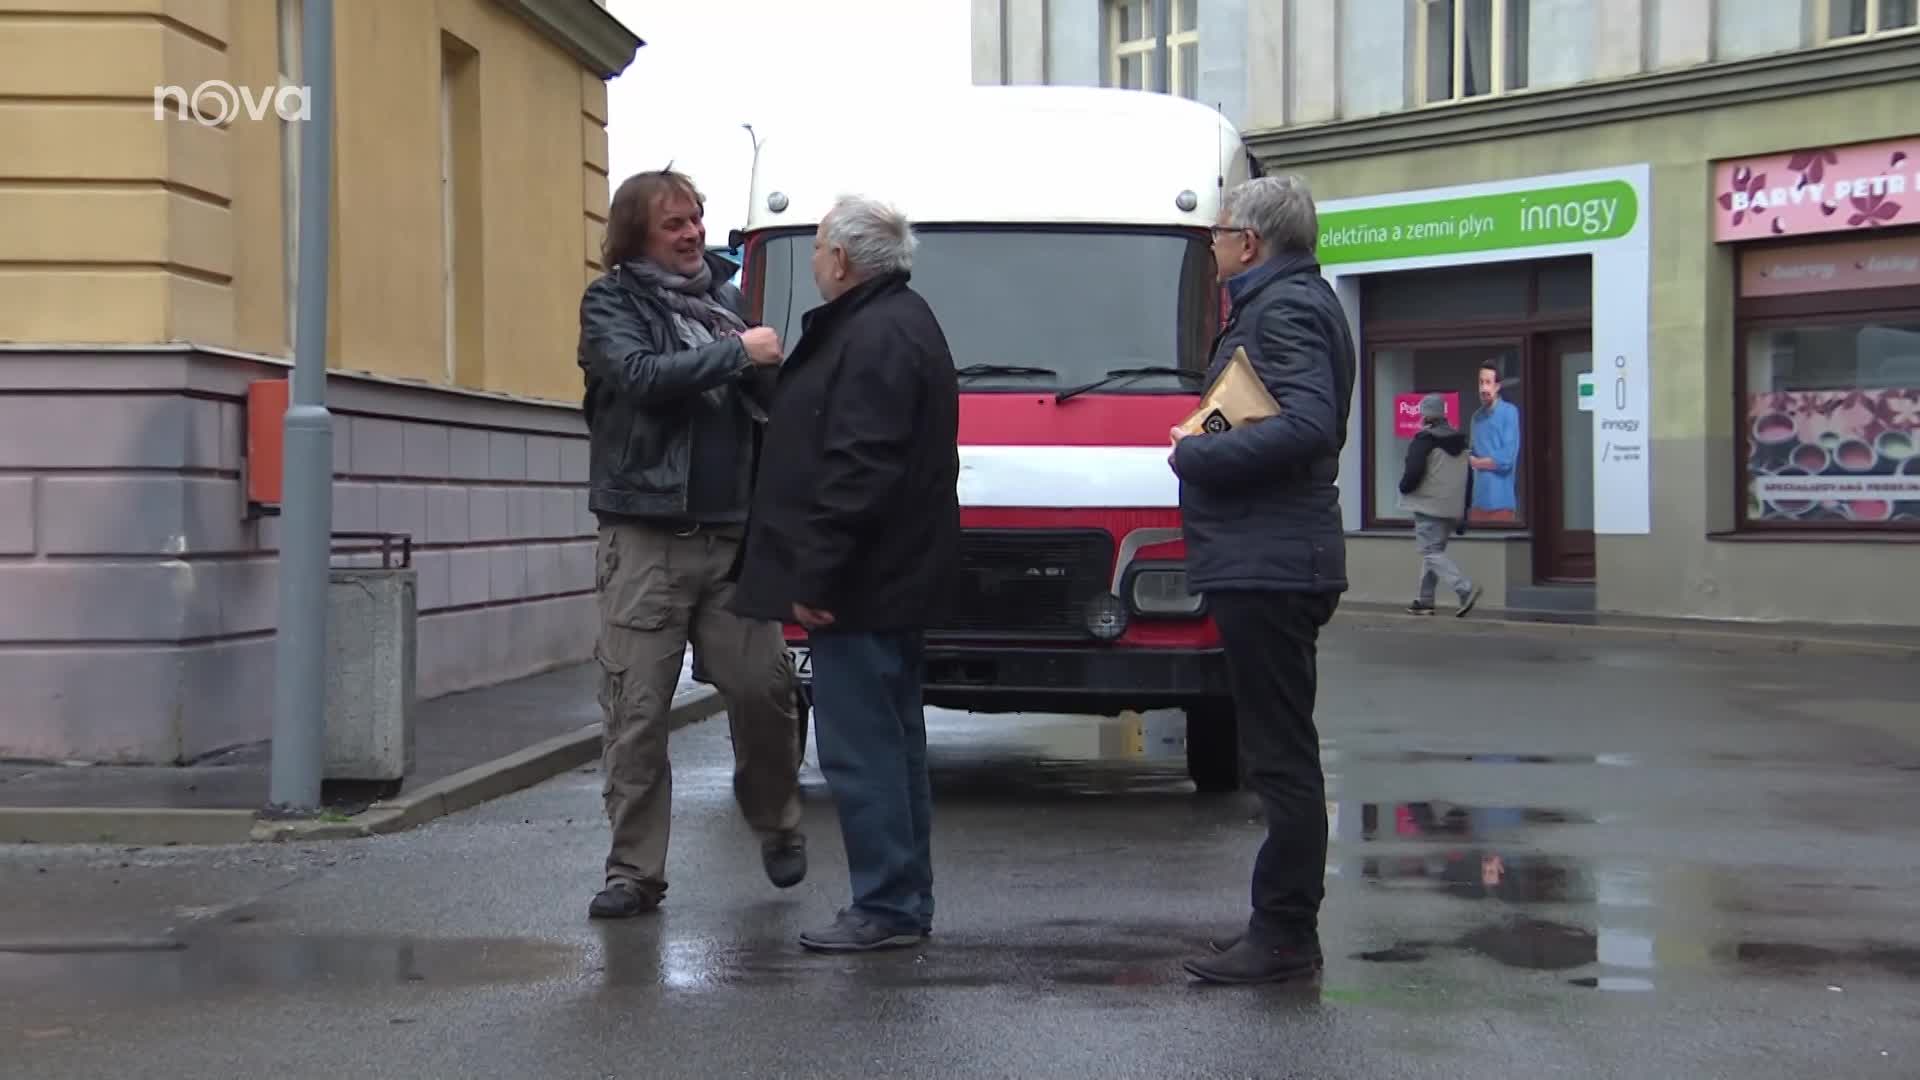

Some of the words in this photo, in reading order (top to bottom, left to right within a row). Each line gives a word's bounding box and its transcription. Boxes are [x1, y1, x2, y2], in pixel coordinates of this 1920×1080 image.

[1732, 183, 1825, 211] BARVY
[1834, 173, 1906, 200] PETR
[1391, 225, 1401, 241] a
[1458, 213, 1494, 241] plyn
[1519, 196, 1618, 235] innogy
